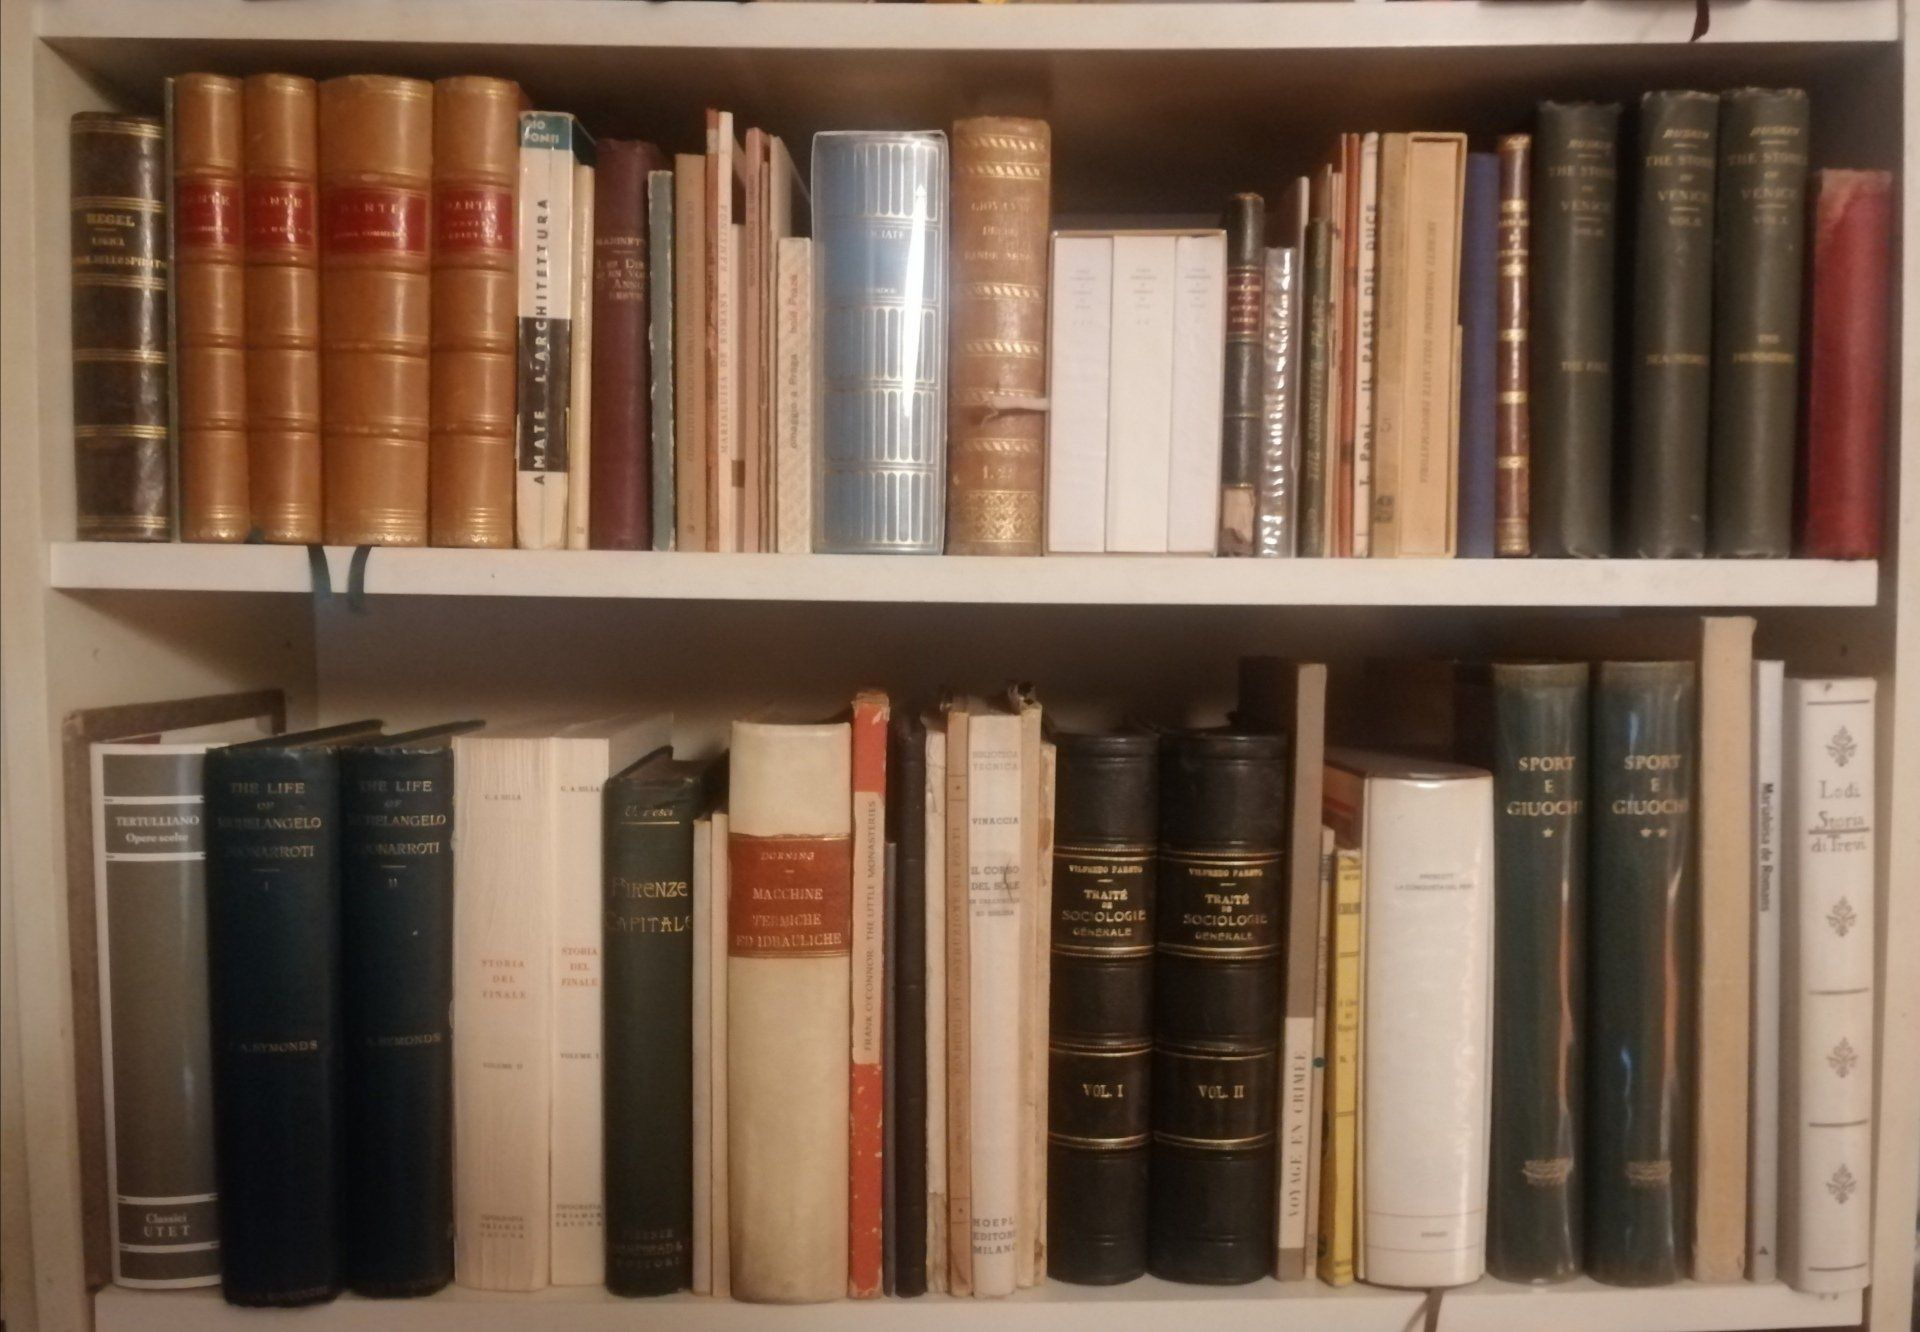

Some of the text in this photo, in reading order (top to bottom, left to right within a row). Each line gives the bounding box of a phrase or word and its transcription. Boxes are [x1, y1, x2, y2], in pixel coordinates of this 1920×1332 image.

[533, 198, 549, 487] AMATE L'ARCHITETTURA
[789, 353, 800, 387] Praga
[792, 390, 799, 398] a
[788, 404, 800, 449] omaggio
[972, 762, 1019, 771] TECNICA
[1518, 754, 1576, 772] SPORT
[1623, 753, 1682, 772] SPORT
[229, 781, 307, 794] THE LIFE
[360, 779, 434, 793] THE LIFE
[1544, 779, 1554, 794] E
[1650, 777, 1660, 793] E
[1818, 779, 1861, 799] Lodi
[1506, 800, 1583, 817] GIUOCHI
[1611, 798, 1690, 816] GIUOCHI
[115, 814, 201, 828] TERTULLIANO
[971, 816, 1020, 826] VINACCIA
[1817, 810, 1864, 831] Storia
[125, 832, 189, 846] Opere scelte
[868, 800, 877, 878] MONASTERIES
[1810, 834, 1866, 853] di Trevi
[1761, 846, 1772, 862] de
[970, 865, 1020, 875] IL CORSO
[1068, 864, 1143, 874] VILFREDO PARETO
[1188, 868, 1264, 877] VILFREDO PARETO
[970, 880, 1021, 891] DEL SOLE
[1760, 865, 1773, 913] Romans
[751, 887, 824, 901] MACCHINE
[1082, 888, 1128, 900] TRAITÉ
[1204, 892, 1250, 905] TRAITÉ
[867, 885, 876, 918] LITTLE
[752, 913, 822, 928] TERMICHE
[1061, 909, 1147, 922] SOCIOLOGIE
[1182, 913, 1268, 927] SOCIOLOGIE
[867, 920, 876, 941] THE
[735, 932, 843, 948] ED IDRAULICHE
[561, 948, 599, 957] STORIA
[481, 959, 526, 969] STORIA
[569, 963, 591, 971] DEL
[492, 975, 516, 984] DEL
[560, 978, 599, 987] FINALE
[481, 990, 528, 1000] FINALE
[865, 1018, 873, 1052] FRANK
[560, 1052, 592, 1060] VOLUME
[482, 1062, 514, 1070] VOLUME
[1082, 1083, 1124, 1098] VOL. I
[1197, 1084, 1245, 1099] VOL. II
[1291, 1124, 1305, 1146] EN
[1288, 1154, 1305, 1218] VOYAGE
[145, 1212, 188, 1224] Classici
